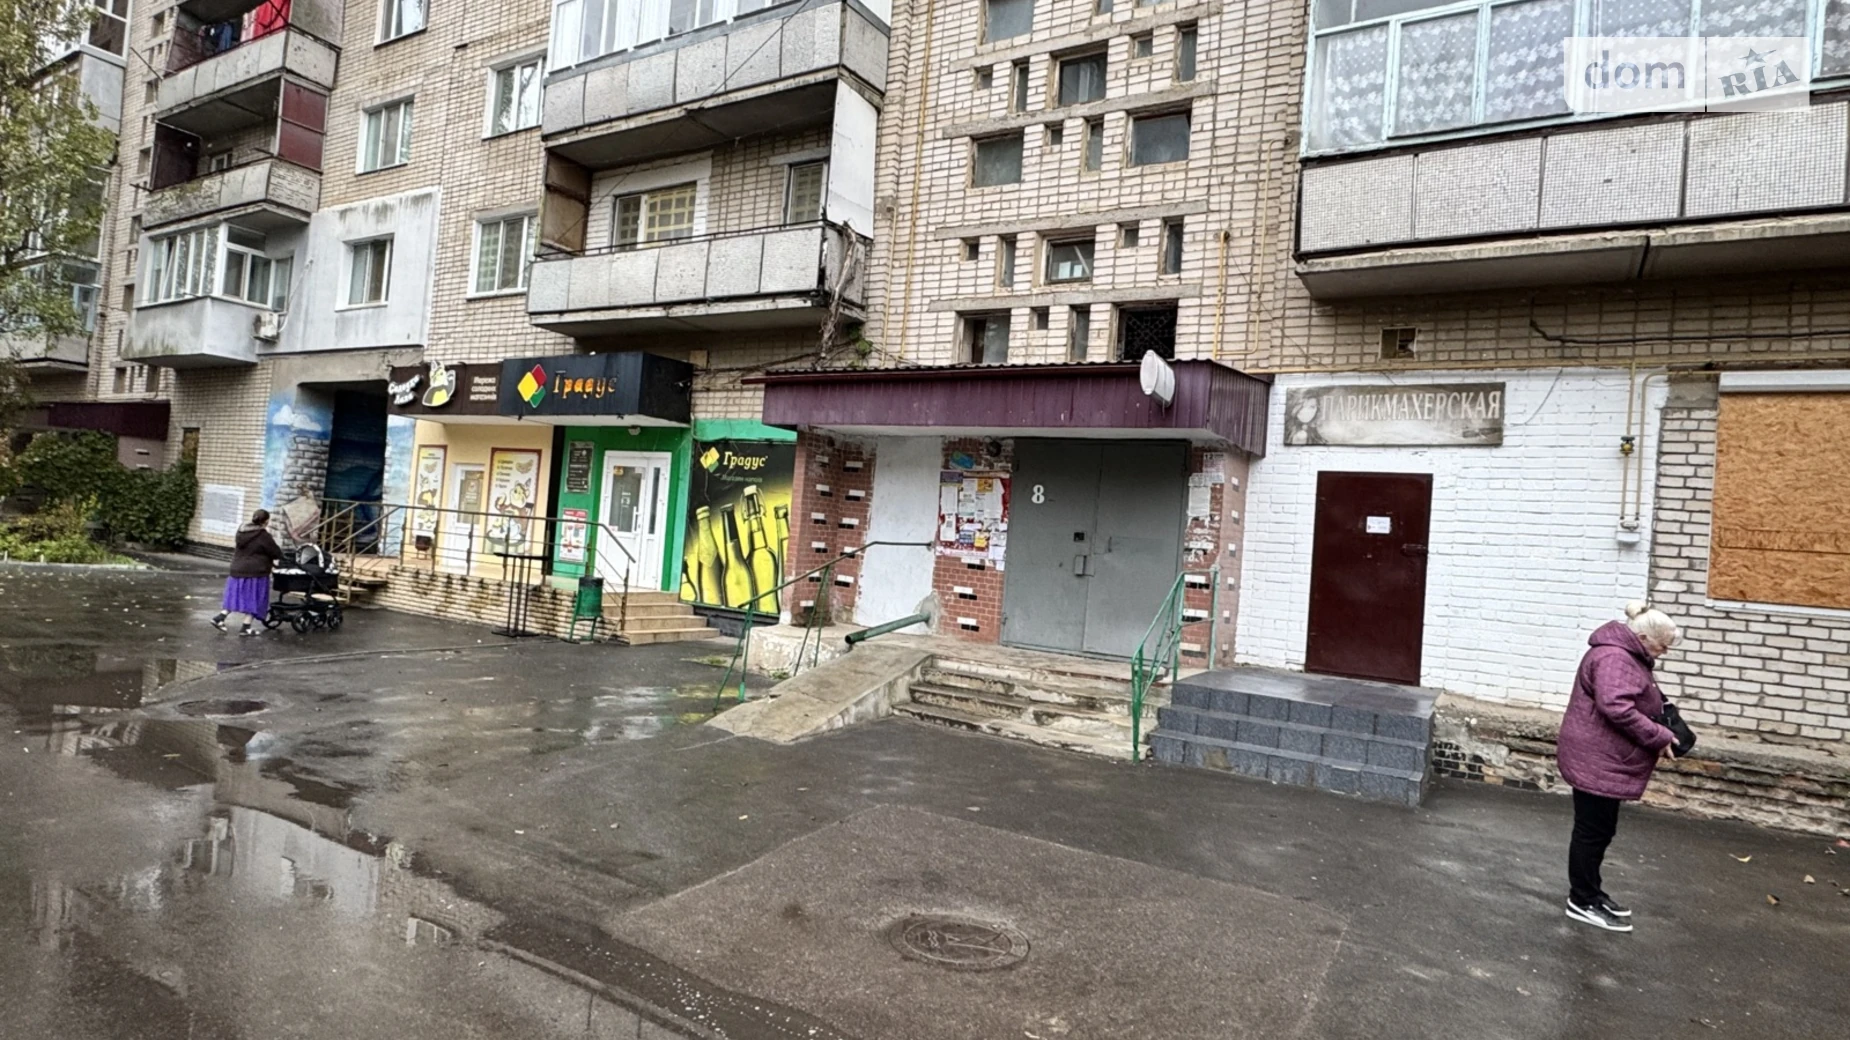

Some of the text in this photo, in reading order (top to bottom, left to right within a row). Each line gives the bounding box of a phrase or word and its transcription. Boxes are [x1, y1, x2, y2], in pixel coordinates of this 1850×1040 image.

[553, 370, 617, 399] Градус
[1321, 391, 1502, 422] ПАРИКМАХЕРСКАЯ
[722, 451, 766, 470] Градус
[1031, 484, 1045, 504] 8
